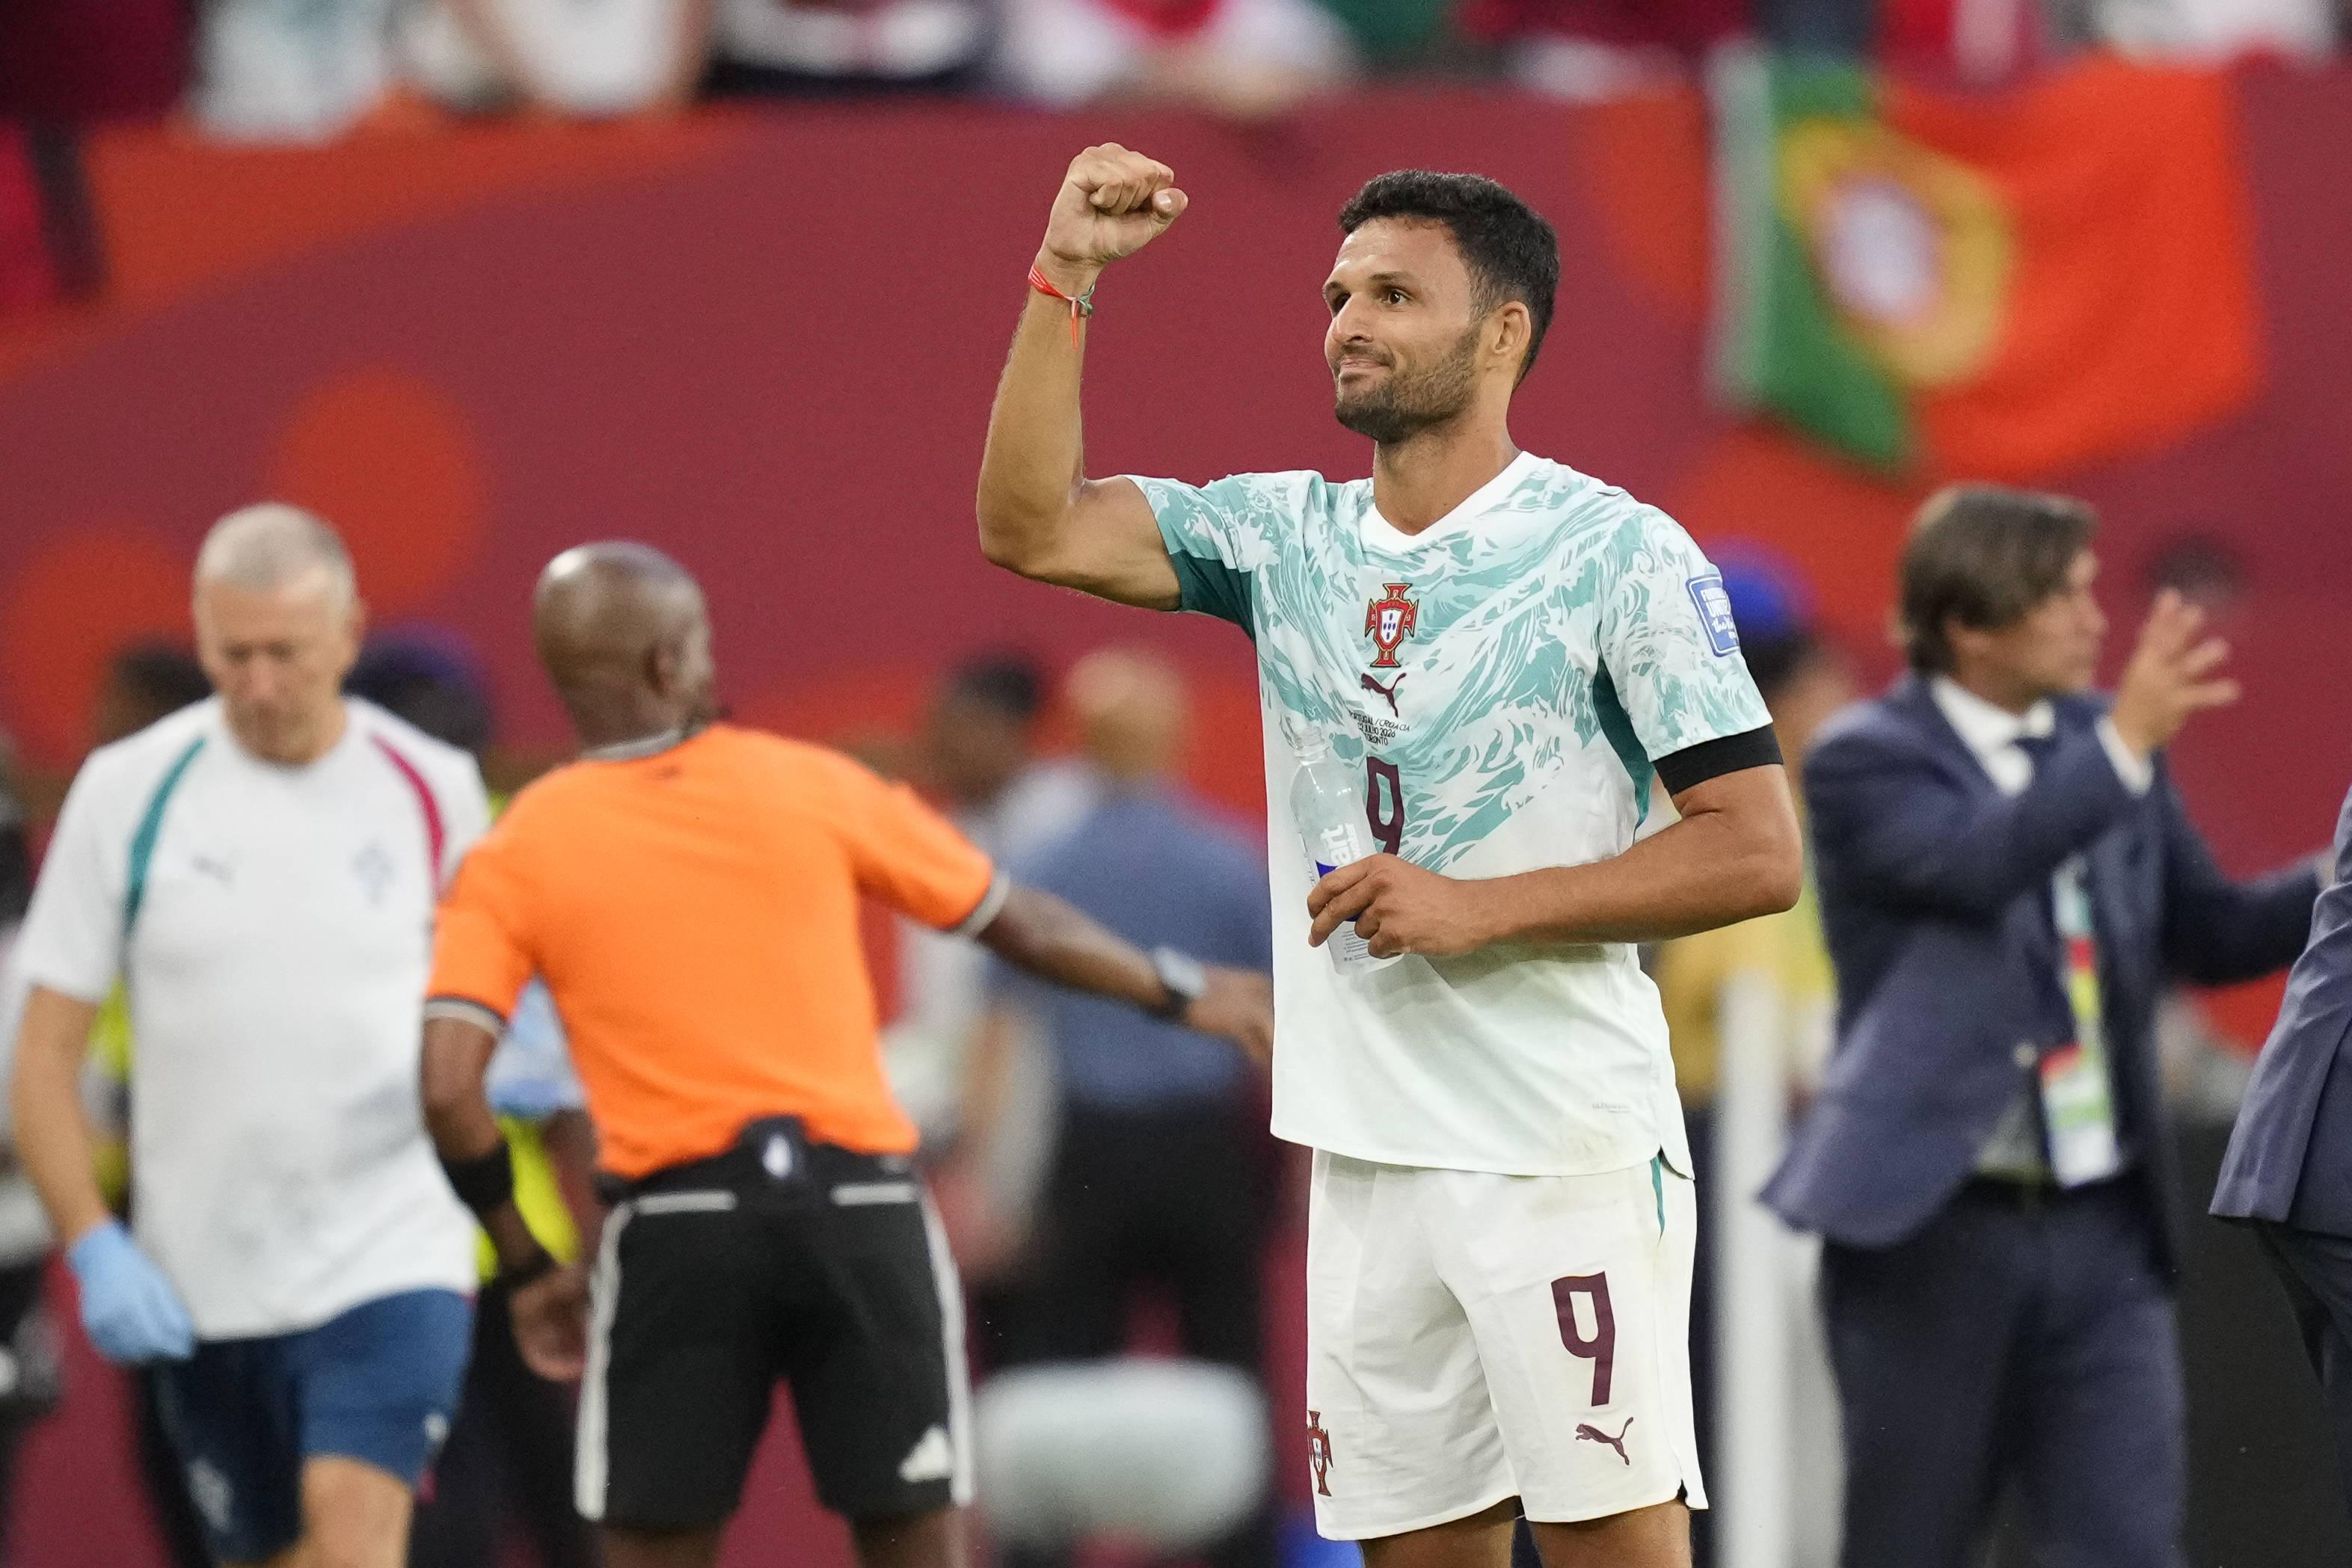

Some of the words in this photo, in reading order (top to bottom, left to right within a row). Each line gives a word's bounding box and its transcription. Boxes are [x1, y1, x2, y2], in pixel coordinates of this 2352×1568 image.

[1380, 728, 1395, 738] 2026
[1366, 756, 1404, 855] 9
[1551, 1270, 1615, 1406] 9
